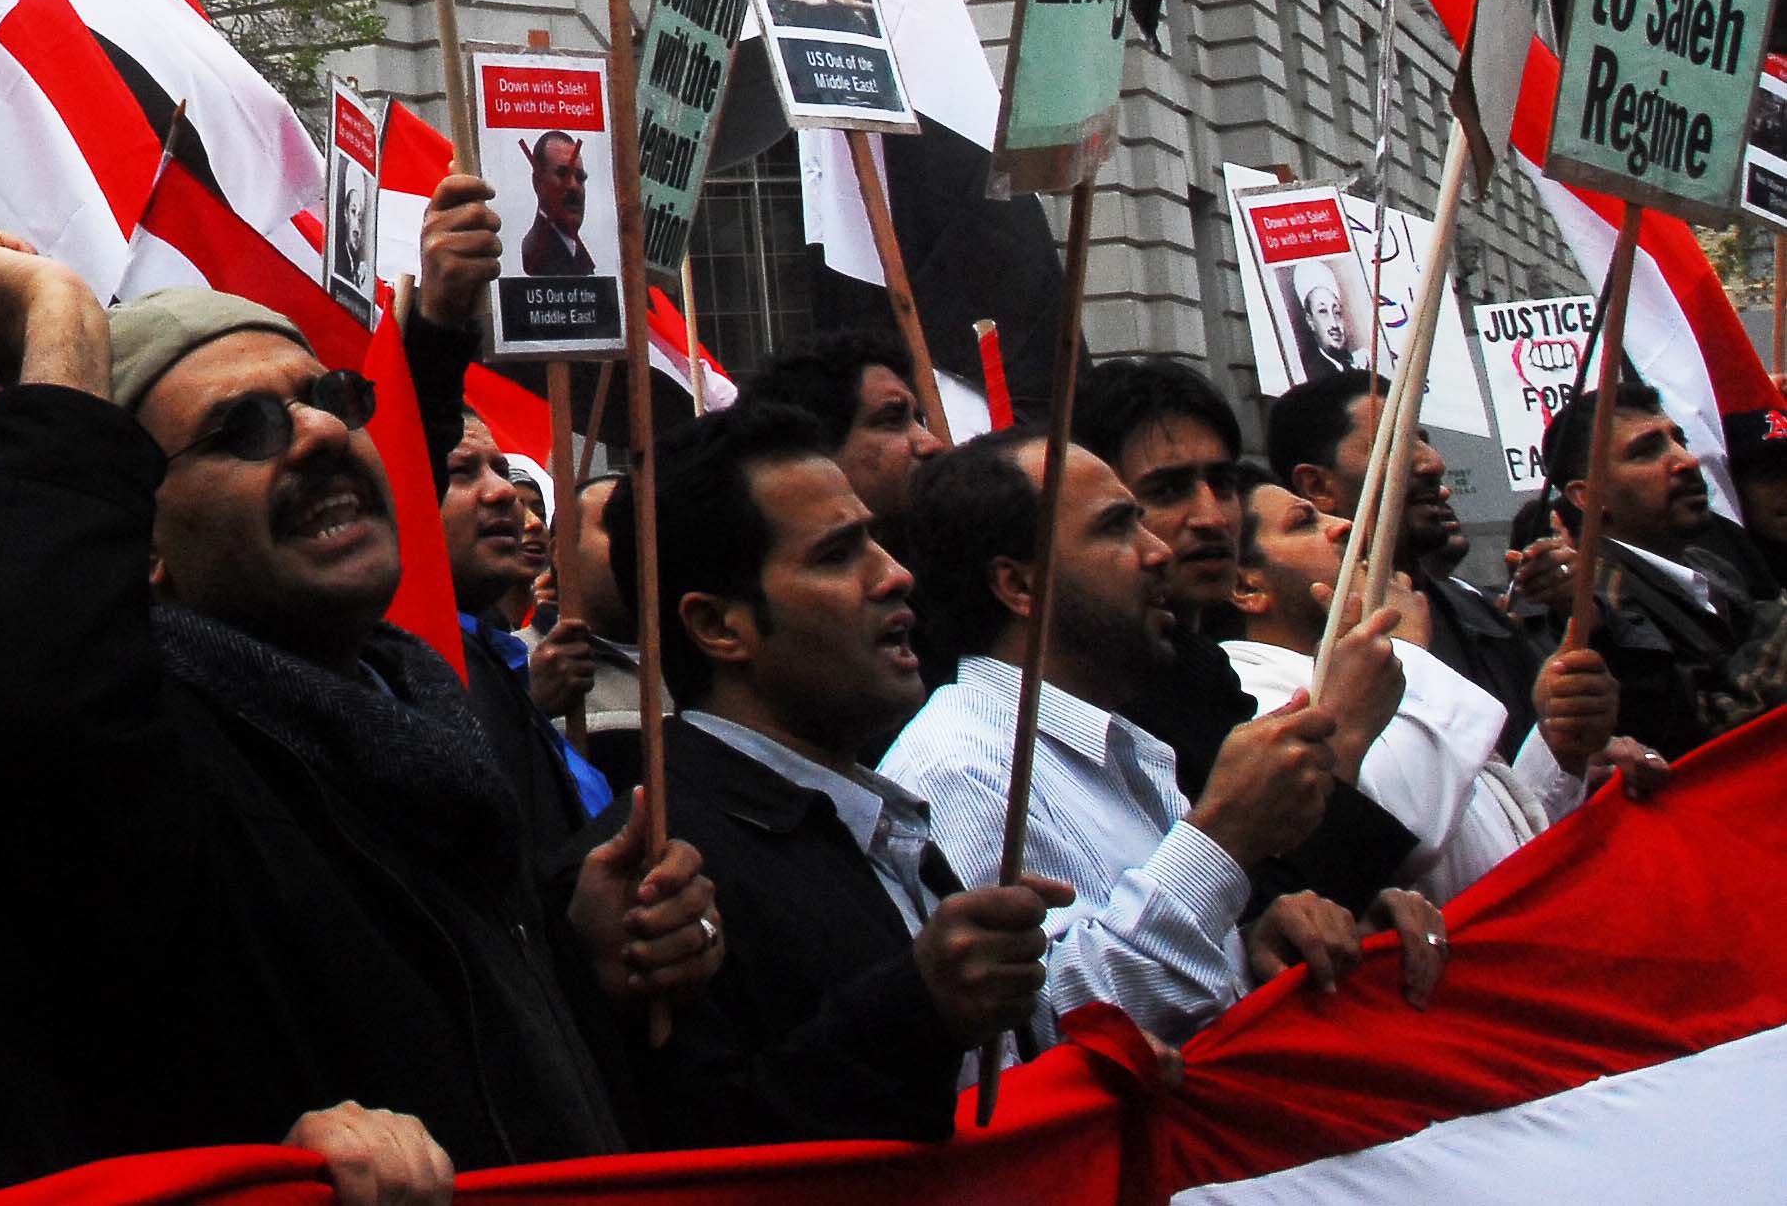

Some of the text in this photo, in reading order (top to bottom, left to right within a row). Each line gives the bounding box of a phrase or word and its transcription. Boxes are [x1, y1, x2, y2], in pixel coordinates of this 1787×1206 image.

[649, 26, 721, 114] with the
[806, 51, 874, 72] US Out of the
[499, 78, 588, 96] Down with Saleh!
[814, 73, 879, 93] Middle East!
[495, 99, 595, 117] Up with the People!
[1580, 45, 1712, 178] Regime
[1263, 216, 1288, 230] Down
[1288, 213, 1307, 226] with
[1265, 235, 1280, 249] Up
[1280, 232, 1299, 246] with
[1298, 231, 1312, 243] the
[526, 288, 596, 304] US Out of the
[529, 309, 596, 324] Middle East!
[1483, 302, 1593, 343] JUSTICE
